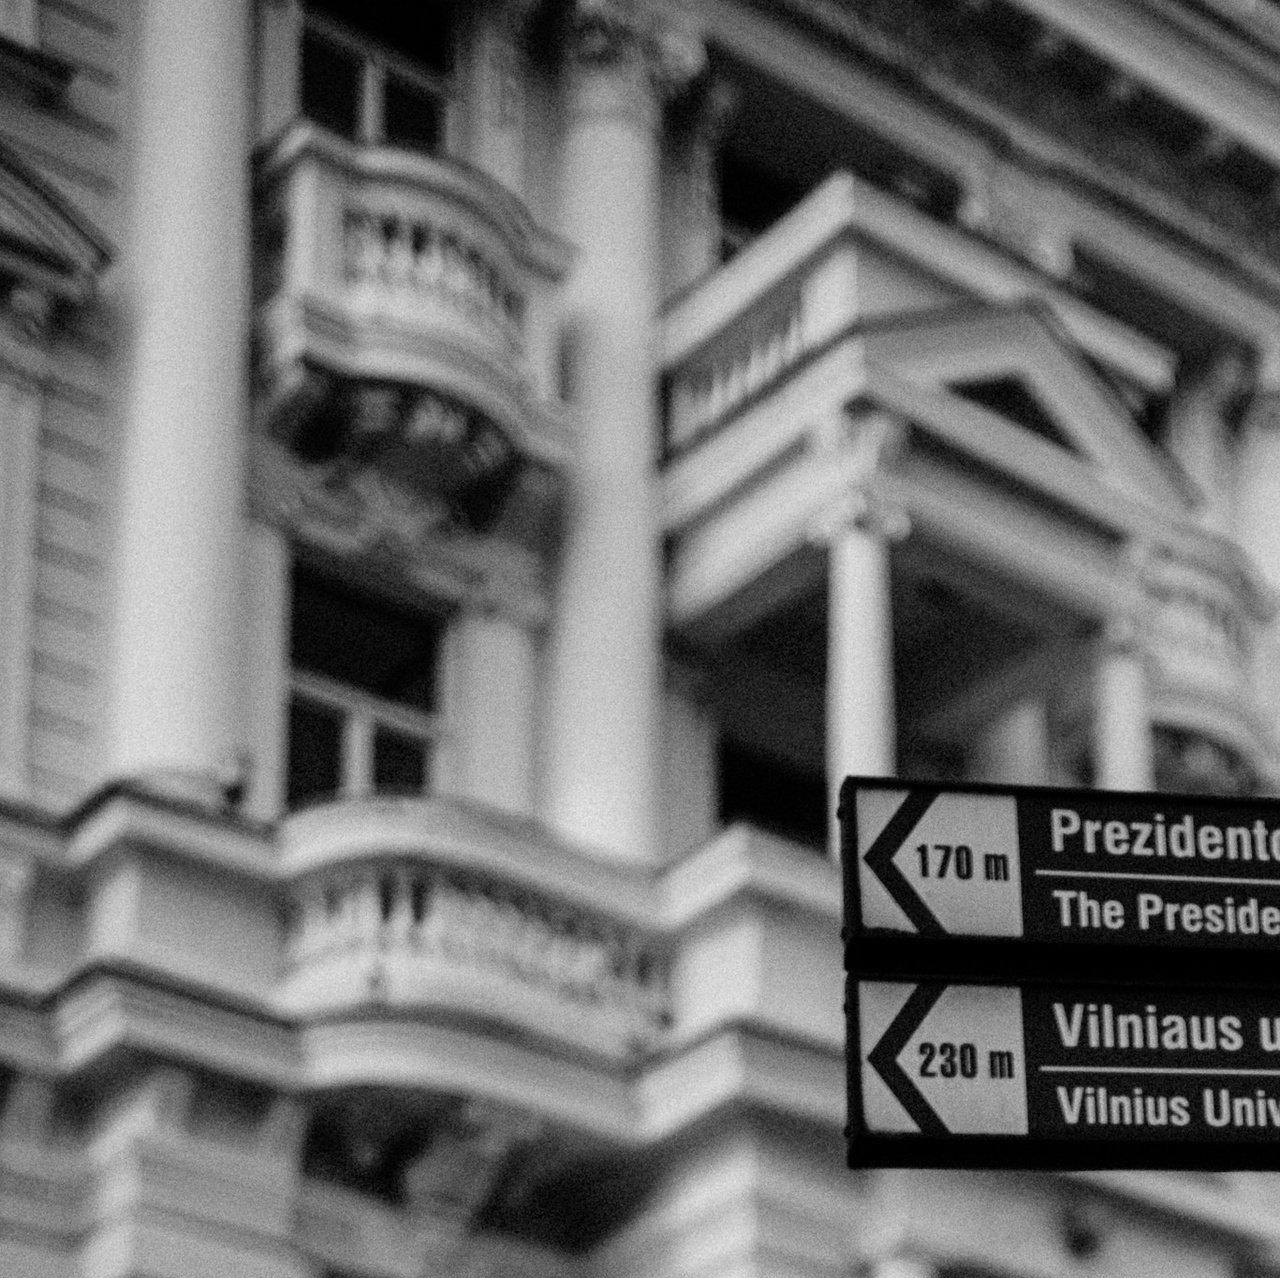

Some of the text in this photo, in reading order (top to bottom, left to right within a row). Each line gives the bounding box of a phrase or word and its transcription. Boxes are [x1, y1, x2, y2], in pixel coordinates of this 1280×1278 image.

[916, 843, 1010, 882] 170 m
[1052, 889, 1125, 930] The
[1053, 1003, 1244, 1052] Vilniaus
[918, 1041, 1015, 1079] 230 m
[1056, 1086, 1190, 1127] Vilnius
